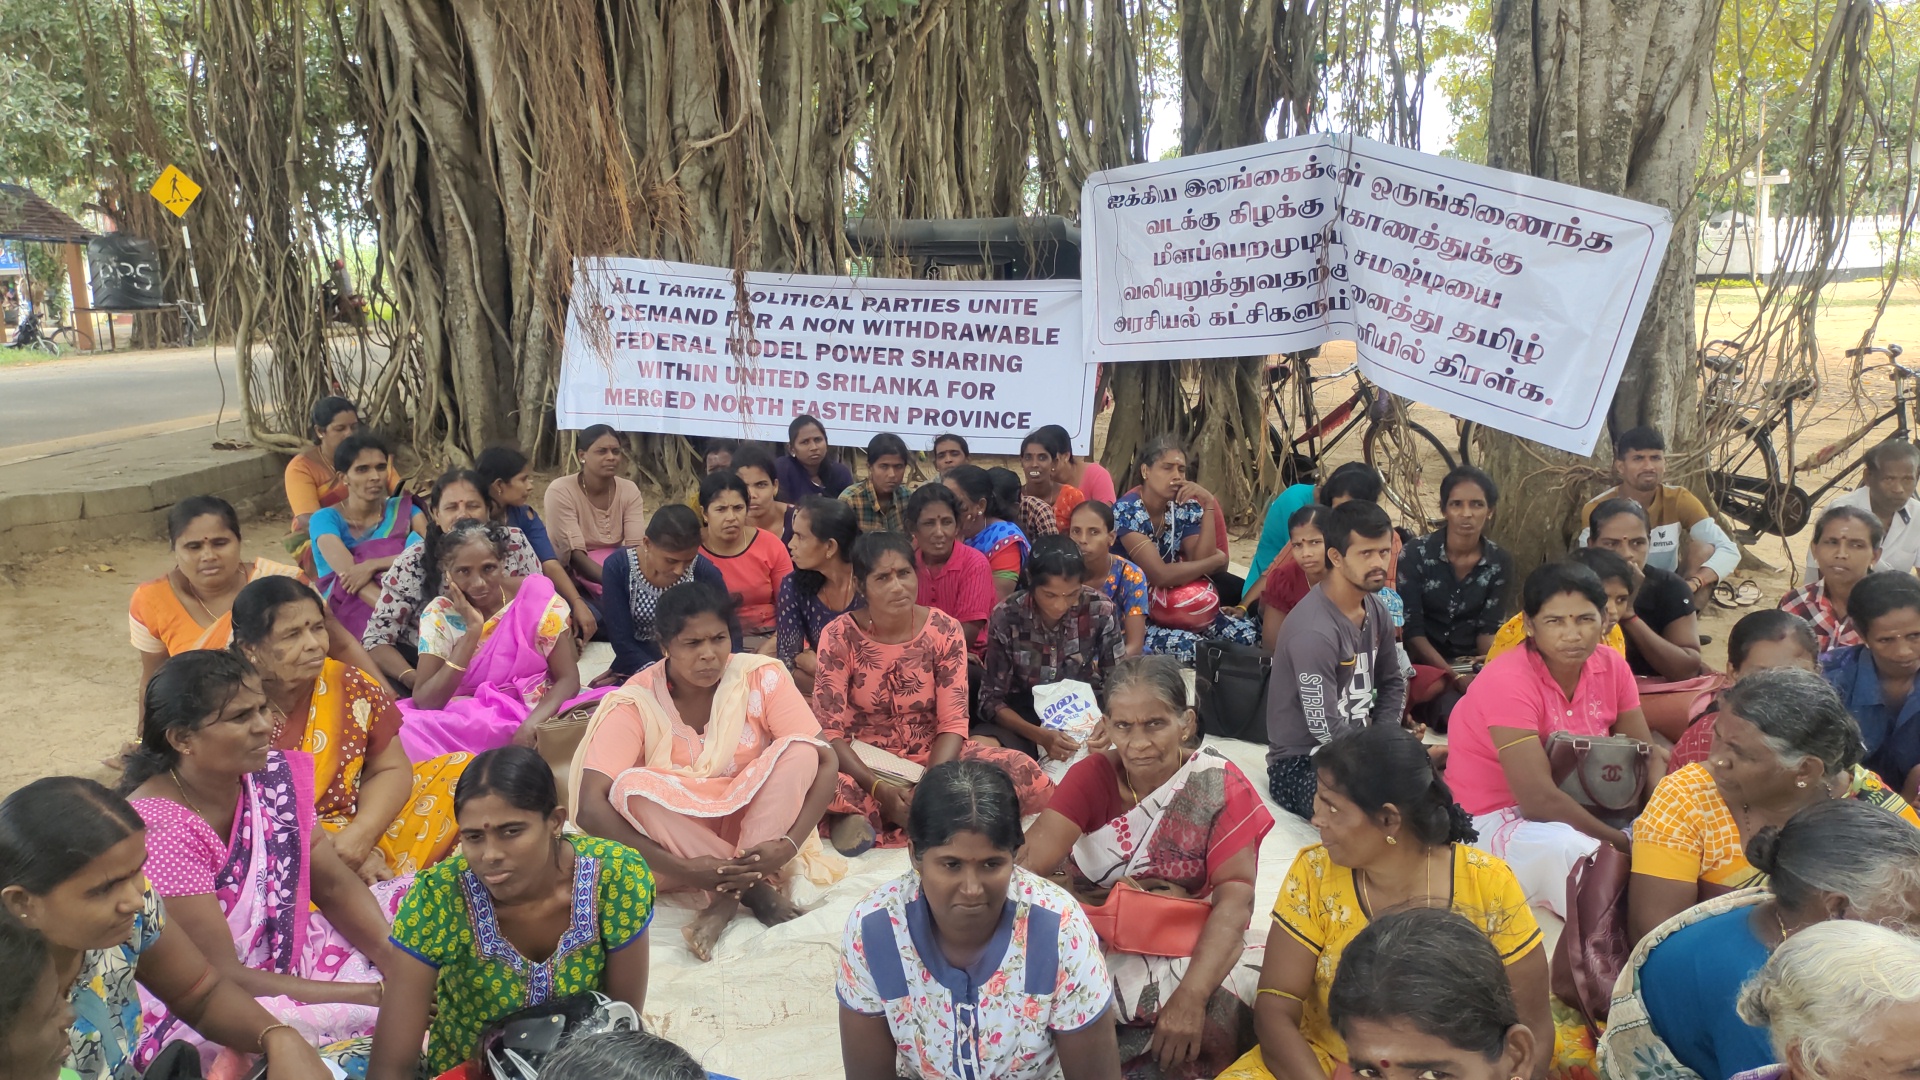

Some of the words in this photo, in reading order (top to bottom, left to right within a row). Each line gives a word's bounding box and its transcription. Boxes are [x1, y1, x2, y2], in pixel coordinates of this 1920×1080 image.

[1107, 185, 1178, 210] ஐக்கிய
[1371, 175, 1614, 254] ஒருங்கிணைந்த
[1146, 207, 1221, 236] வடக்கு
[1229, 194, 1324, 228] கிழக்கு
[611, 276, 650, 295] ALL
[659, 282, 727, 300] TAMIL
[861, 296, 961, 314] PARTIES
[967, 298, 1039, 316] UNITE
[1353, 249, 1503, 310] சமஷ்டியை
[621, 304, 718, 326] DEMAND
[779, 315, 795, 331] A
[802, 317, 855, 335] NON
[862, 319, 1061, 346] WITHDRAWABLE
[1447, 320, 1545, 366] தமிழ்
[616, 331, 717, 355] FEDERAL
[815, 343, 905, 367] POWER
[910, 350, 1024, 374] SHARING
[1113, 305, 1201, 334] அரசியல்
[1208, 288, 1351, 327] கட்சிகளும்
[1429, 353, 1554, 406] திரள்க.
[637, 360, 718, 384] WITHIN
[725, 366, 810, 389] UNITED
[816, 371, 940, 398] SRILANKA
[947, 380, 996, 401] FOR
[604, 387, 696, 410] MERGED
[703, 393, 784, 417] NORTH
[791, 399, 900, 425] EASTERN
[907, 407, 1033, 430] PROVINCE
